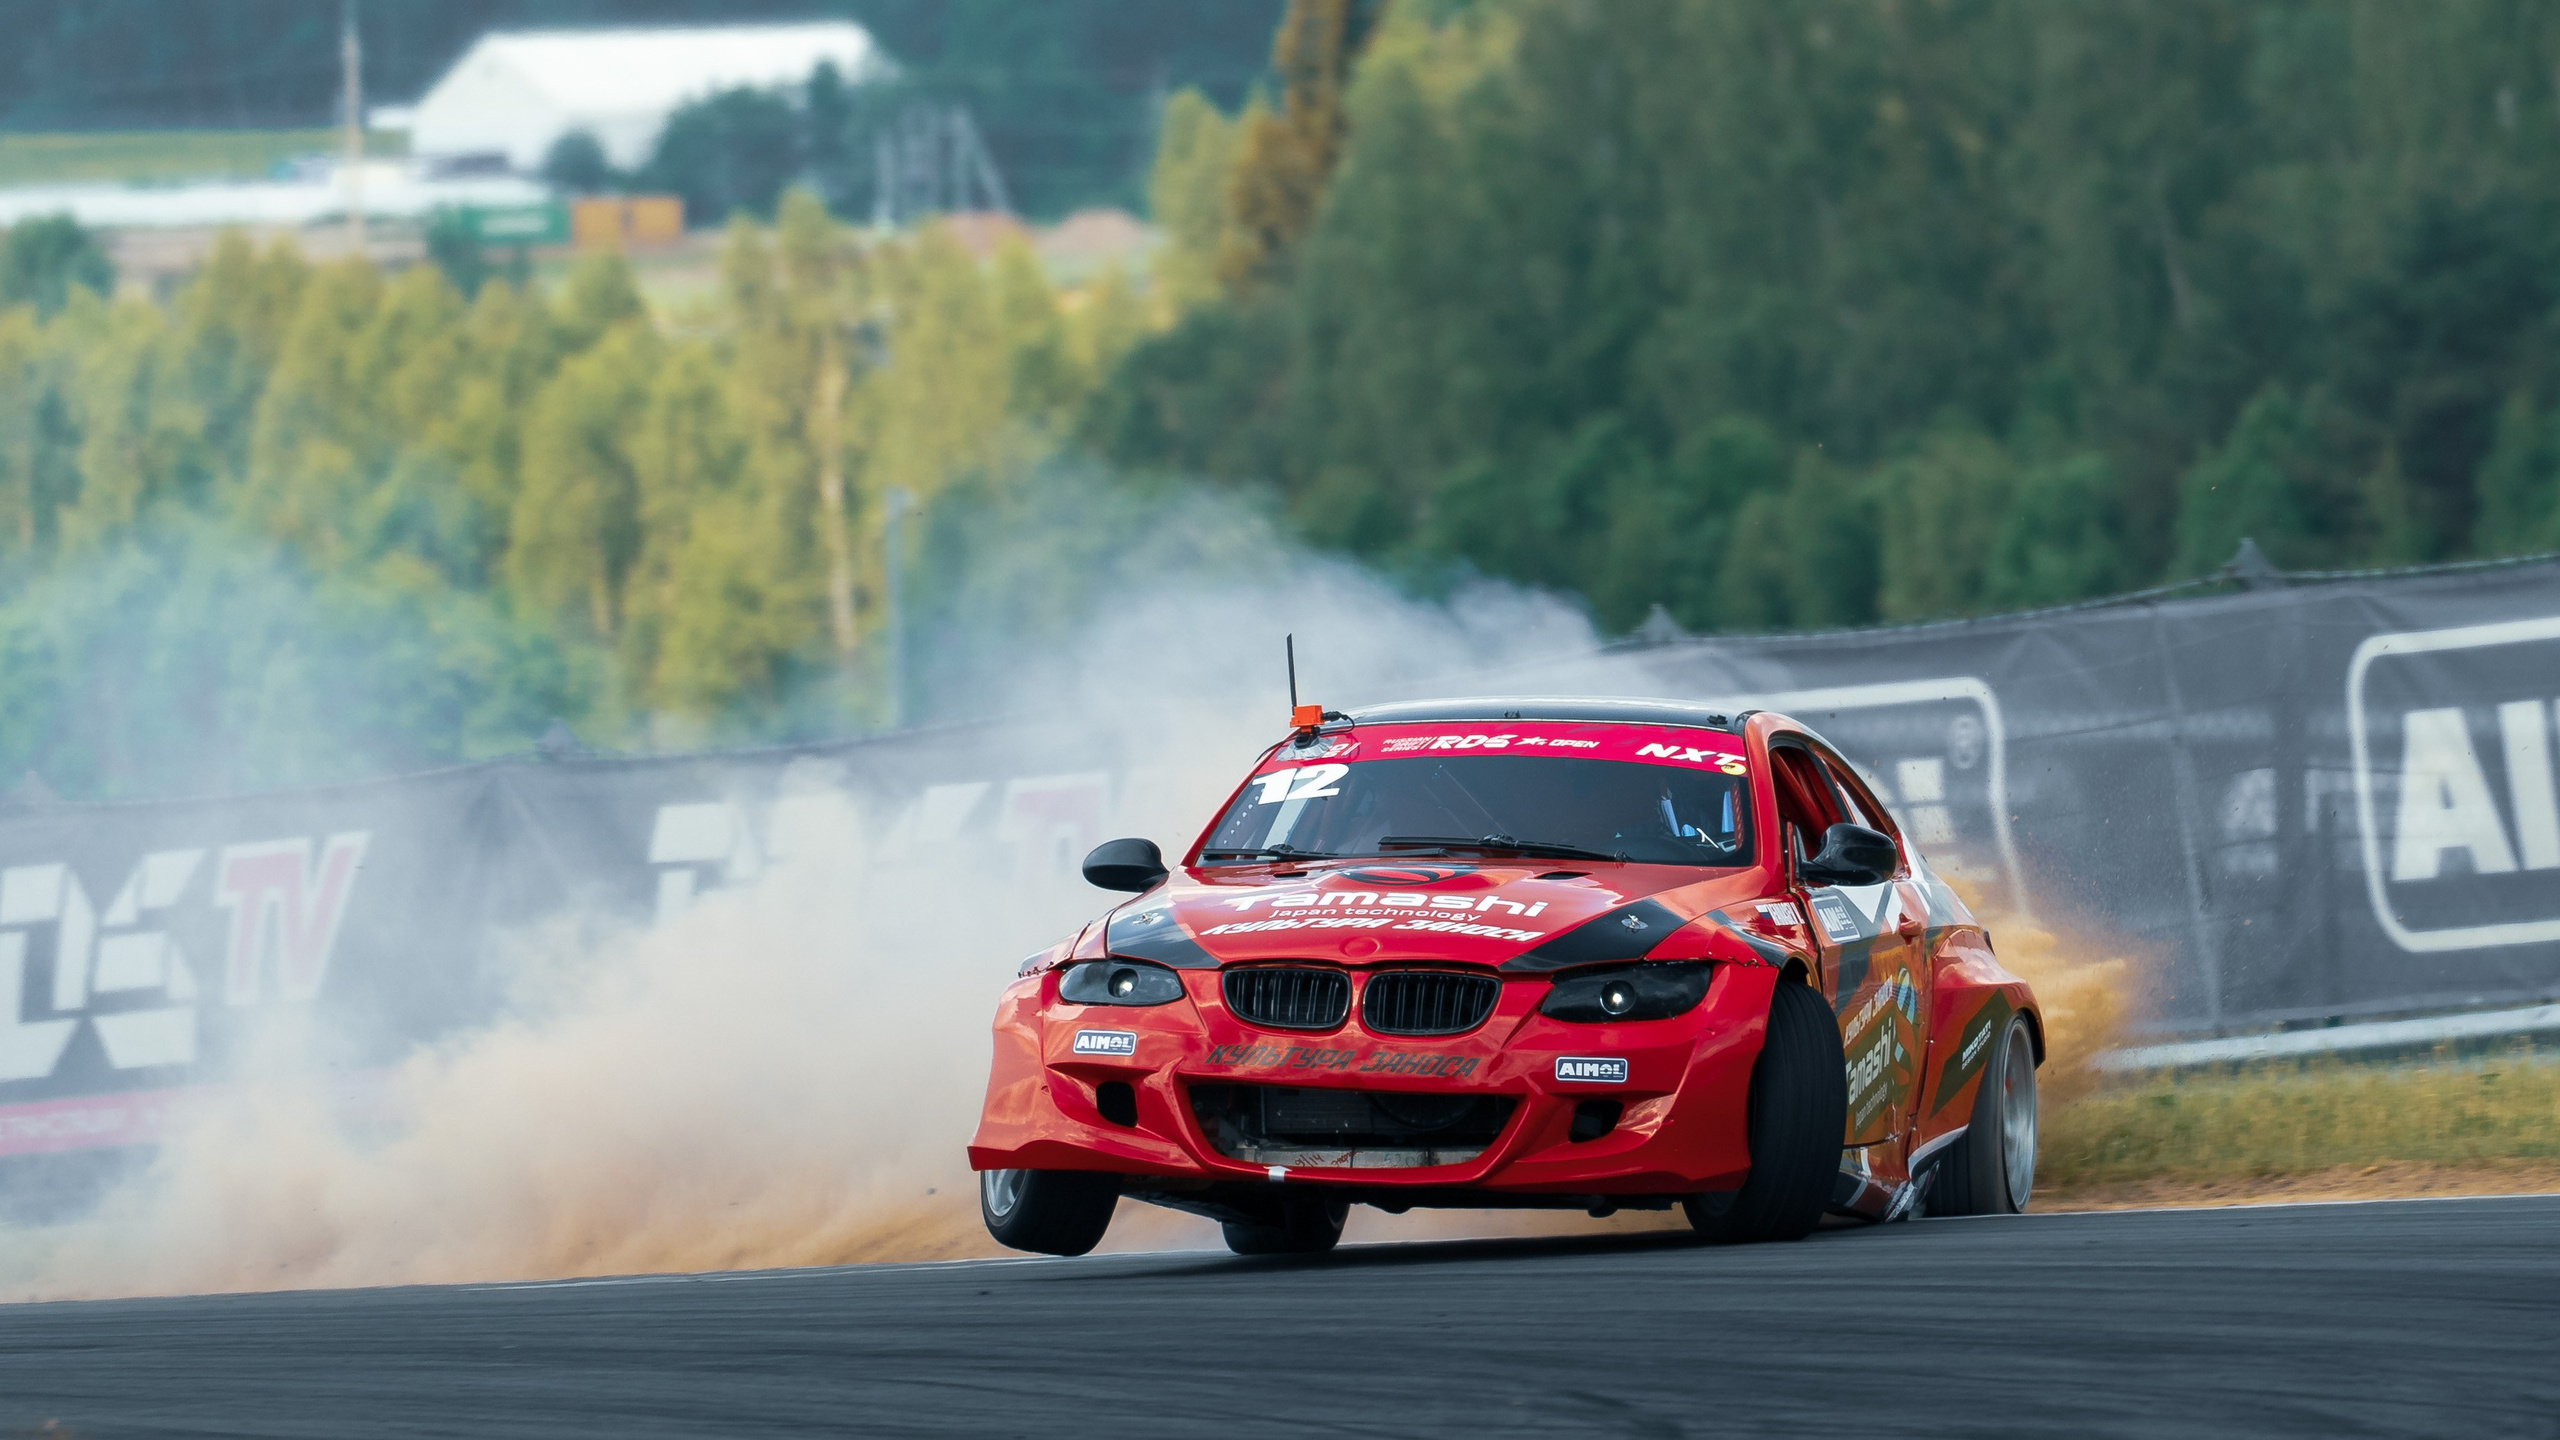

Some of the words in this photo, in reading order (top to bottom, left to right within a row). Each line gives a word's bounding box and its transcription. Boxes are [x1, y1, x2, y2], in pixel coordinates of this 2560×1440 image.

[1429, 735, 1518, 749] RDS
[1548, 739, 1600, 748] OPEN
[1635, 743, 1746, 766] NXT
[1252, 763, 1349, 805] 12
[2390, 697, 2560, 881] AI
[1222, 891, 1549, 917] Tamashi
[1345, 908, 1481, 921] technology
[1200, 917, 1394, 936] КУЛЬТУРА
[1392, 919, 1545, 942] ЗАНОСА
[1076, 1035, 1132, 1050] AIMOL
[1204, 1045, 1357, 1070] КУЛЬТУРА
[1359, 1051, 1482, 1078] ЗАНОСА
[1559, 1063, 1624, 1077] AIMOL
[1846, 1017, 1891, 1105] Tamashi
